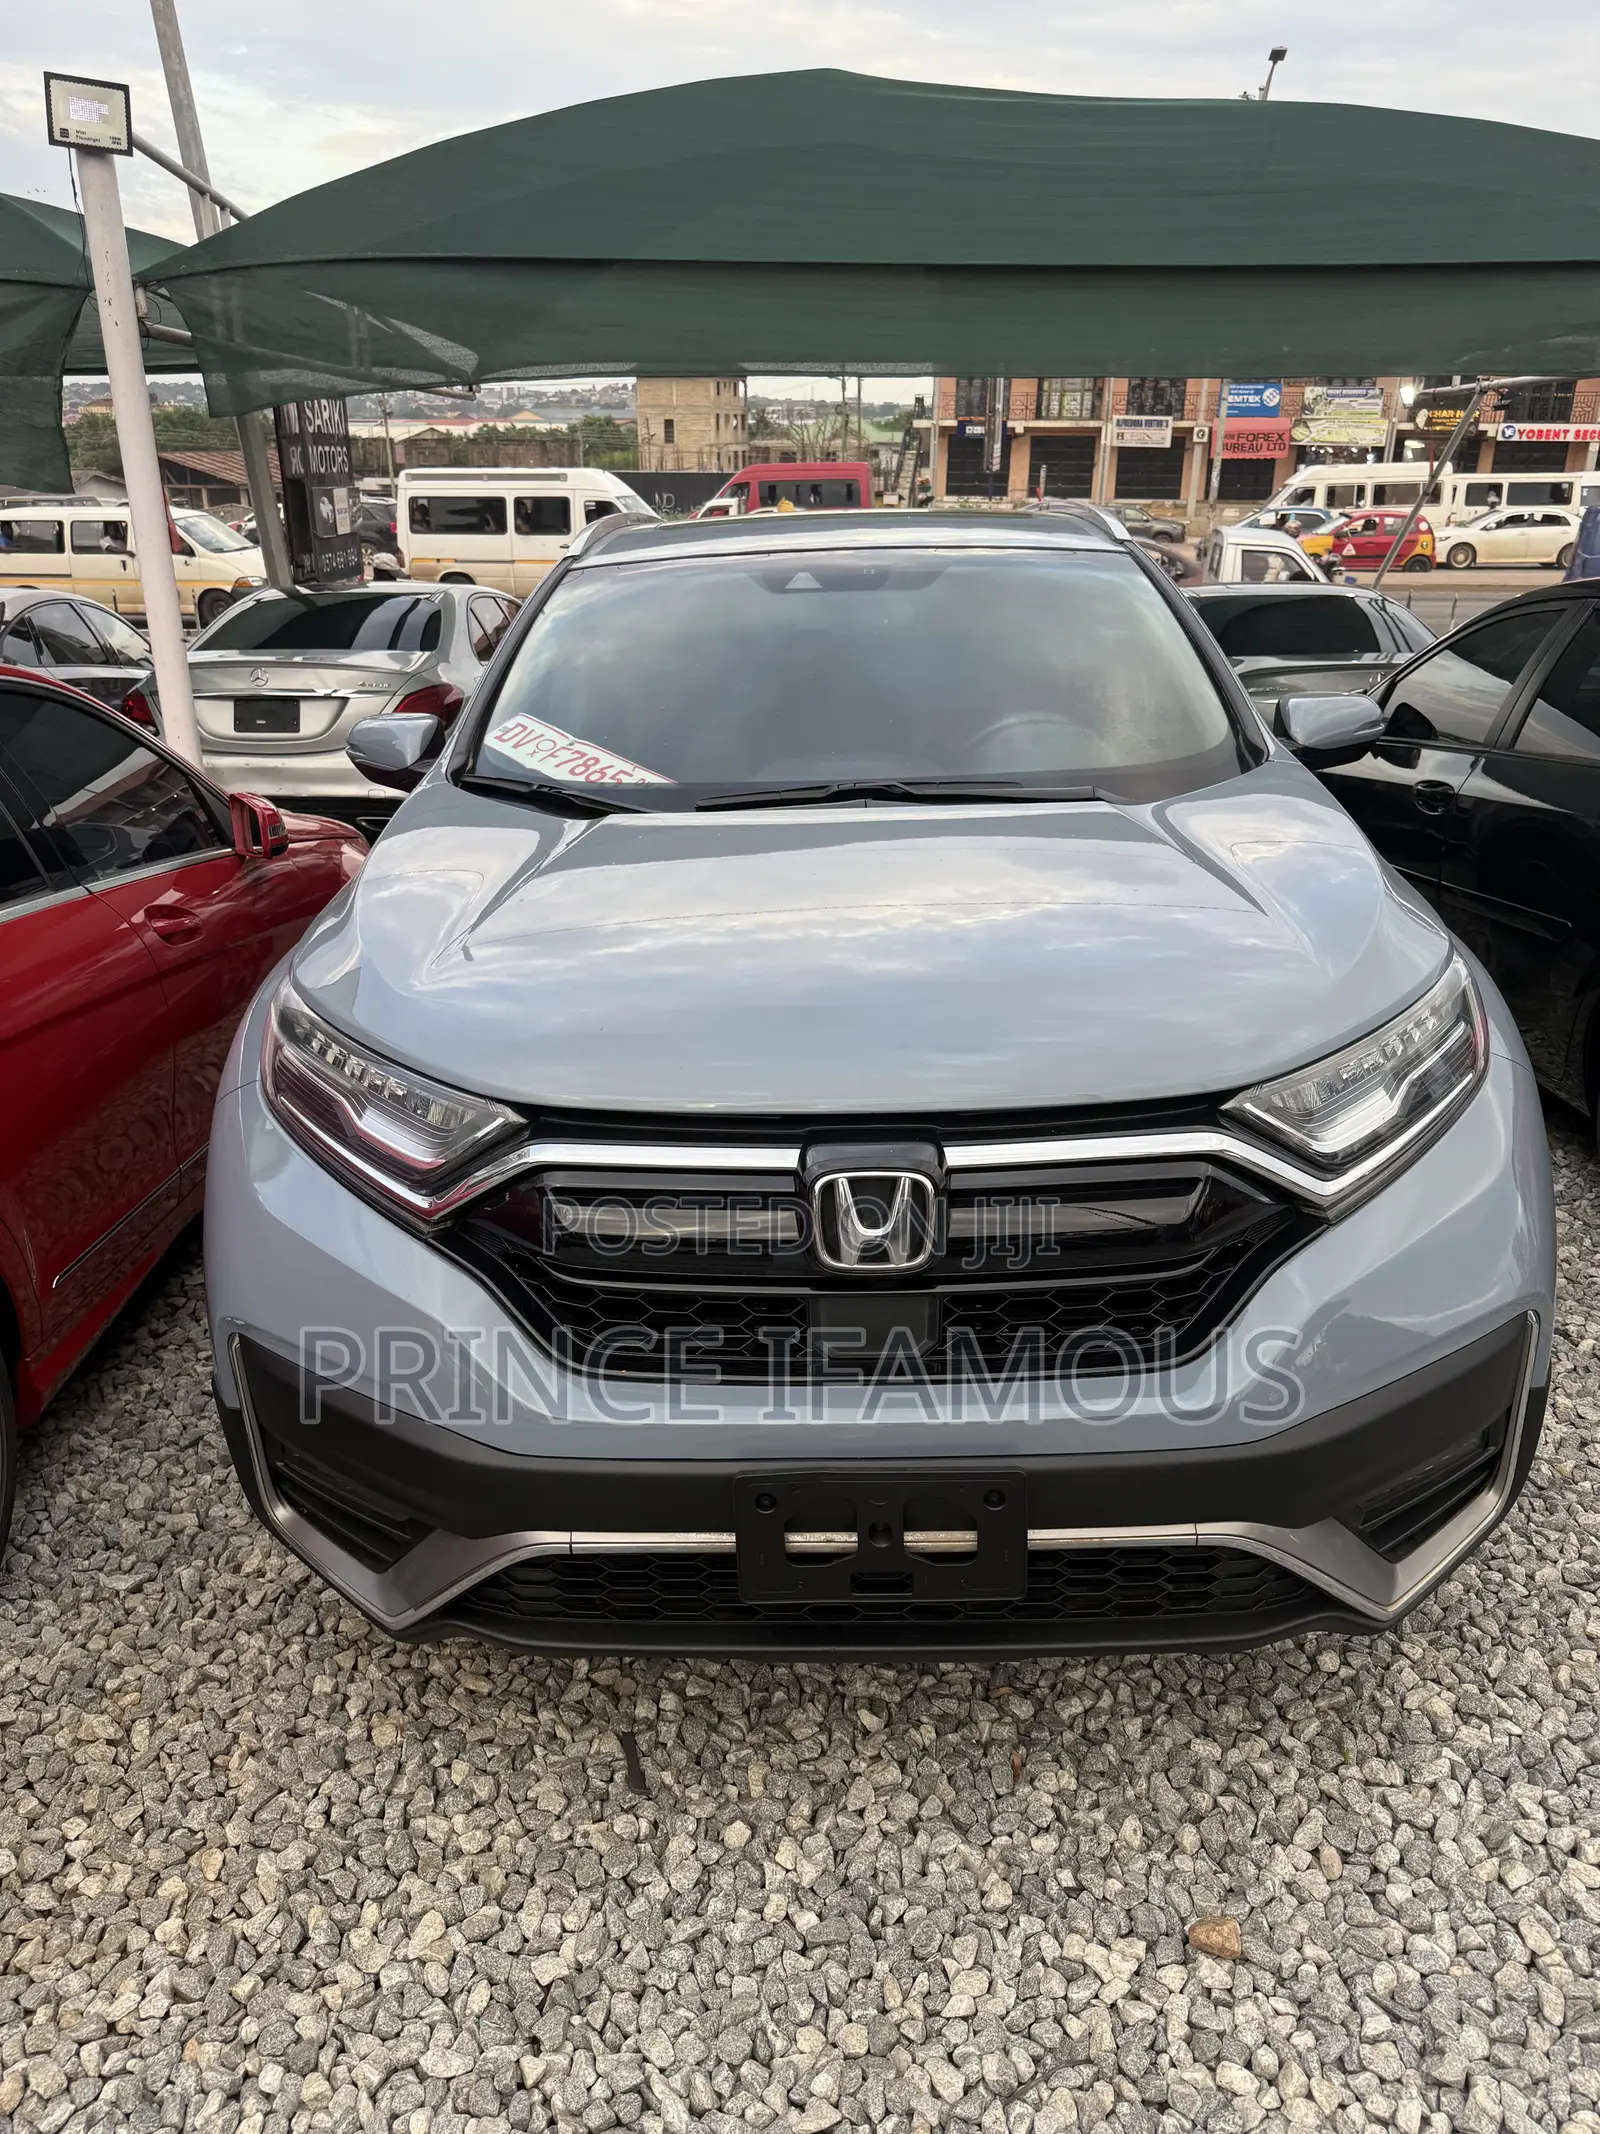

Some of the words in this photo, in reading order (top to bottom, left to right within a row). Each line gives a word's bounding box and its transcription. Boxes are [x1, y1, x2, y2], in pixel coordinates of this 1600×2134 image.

[304, 398, 347, 435] SARIKI
[1236, 432, 1285, 442] FOREX
[1517, 429, 1570, 440] YOBENT
[1266, 443, 1286, 451] LTD
[308, 444, 350, 474] MOTORS
